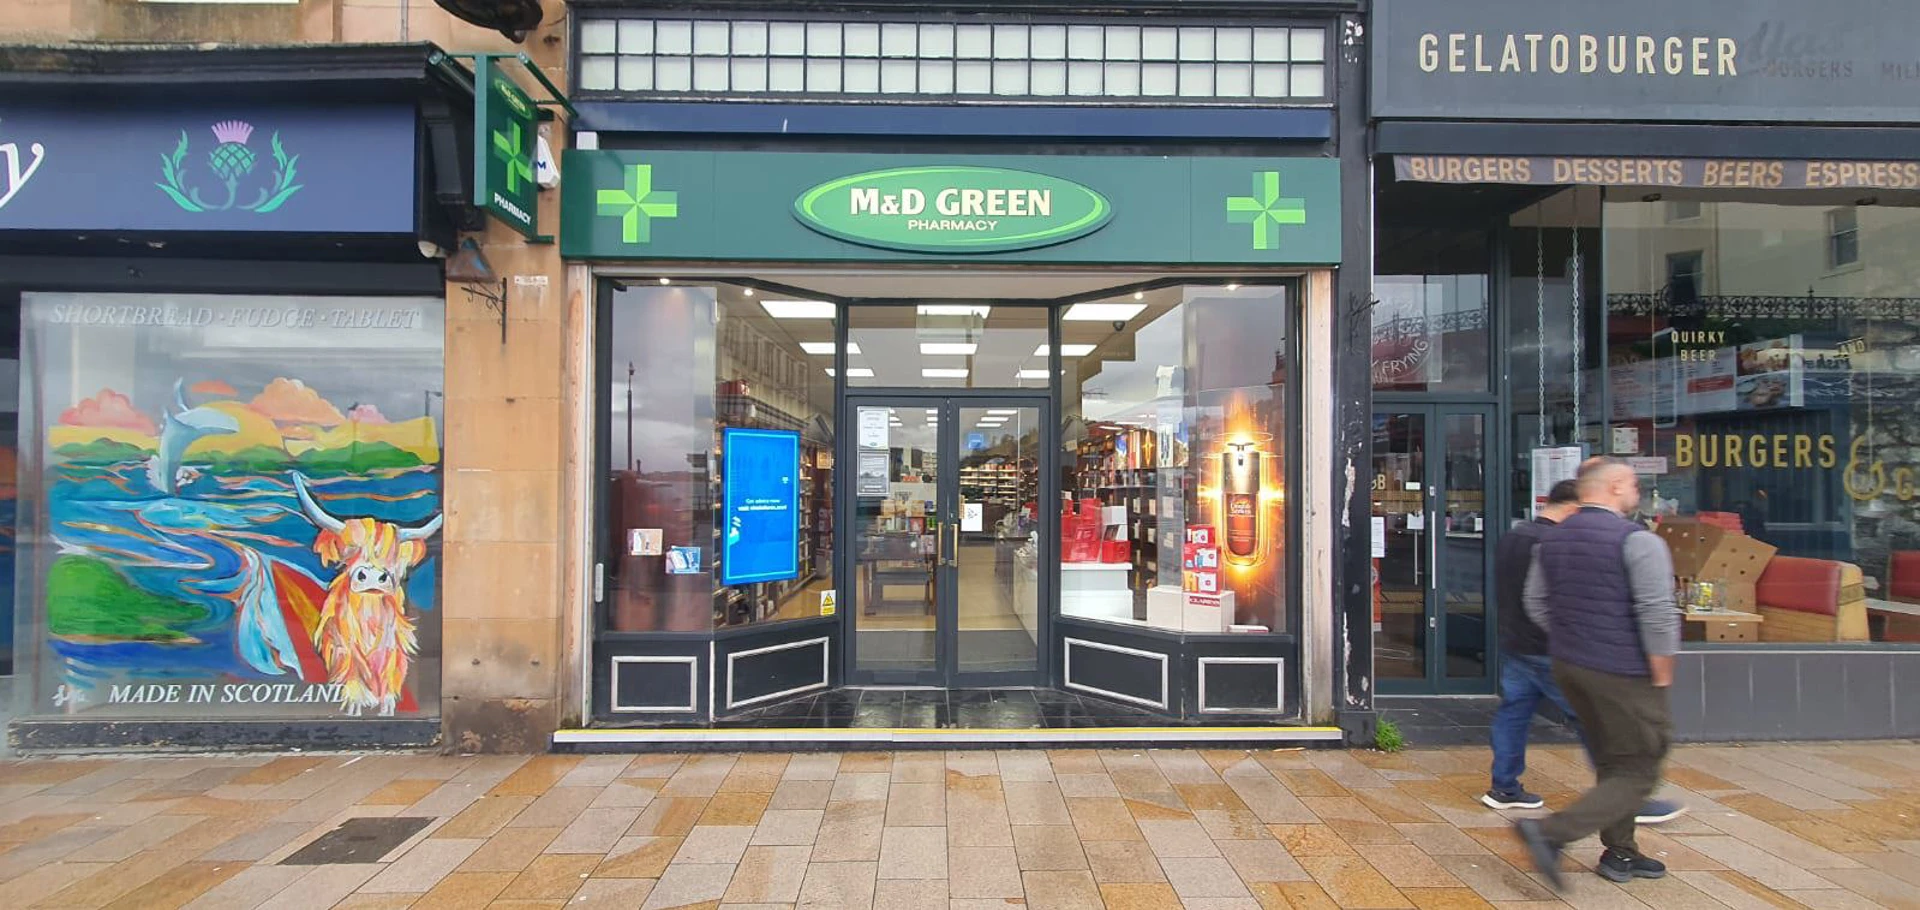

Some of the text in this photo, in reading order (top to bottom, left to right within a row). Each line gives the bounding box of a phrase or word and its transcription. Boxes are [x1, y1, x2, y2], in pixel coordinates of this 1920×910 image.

[1418, 33, 1738, 76] GELATOBURGER
[1411, 157, 1531, 182] BURGERS
[1554, 158, 1683, 185] DESSERTS
[1703, 161, 1784, 186] BEERS
[494, 192, 531, 225] PHARMACY
[851, 188, 1051, 216] M&D GREEN
[908, 219, 998, 231] PHARMACY
[50, 303, 421, 329] SHORTBREAD FUDGE TABLET
[1671, 330, 1725, 344] QUIRKY
[1382, 339, 1429, 374] FRYING
[1680, 349, 1717, 362] BEER
[1675, 434, 1836, 468] BURGERS
[108, 684, 182, 703] MADE
[187, 684, 215, 703] IN
[221, 684, 347, 703] SCOTLAND
